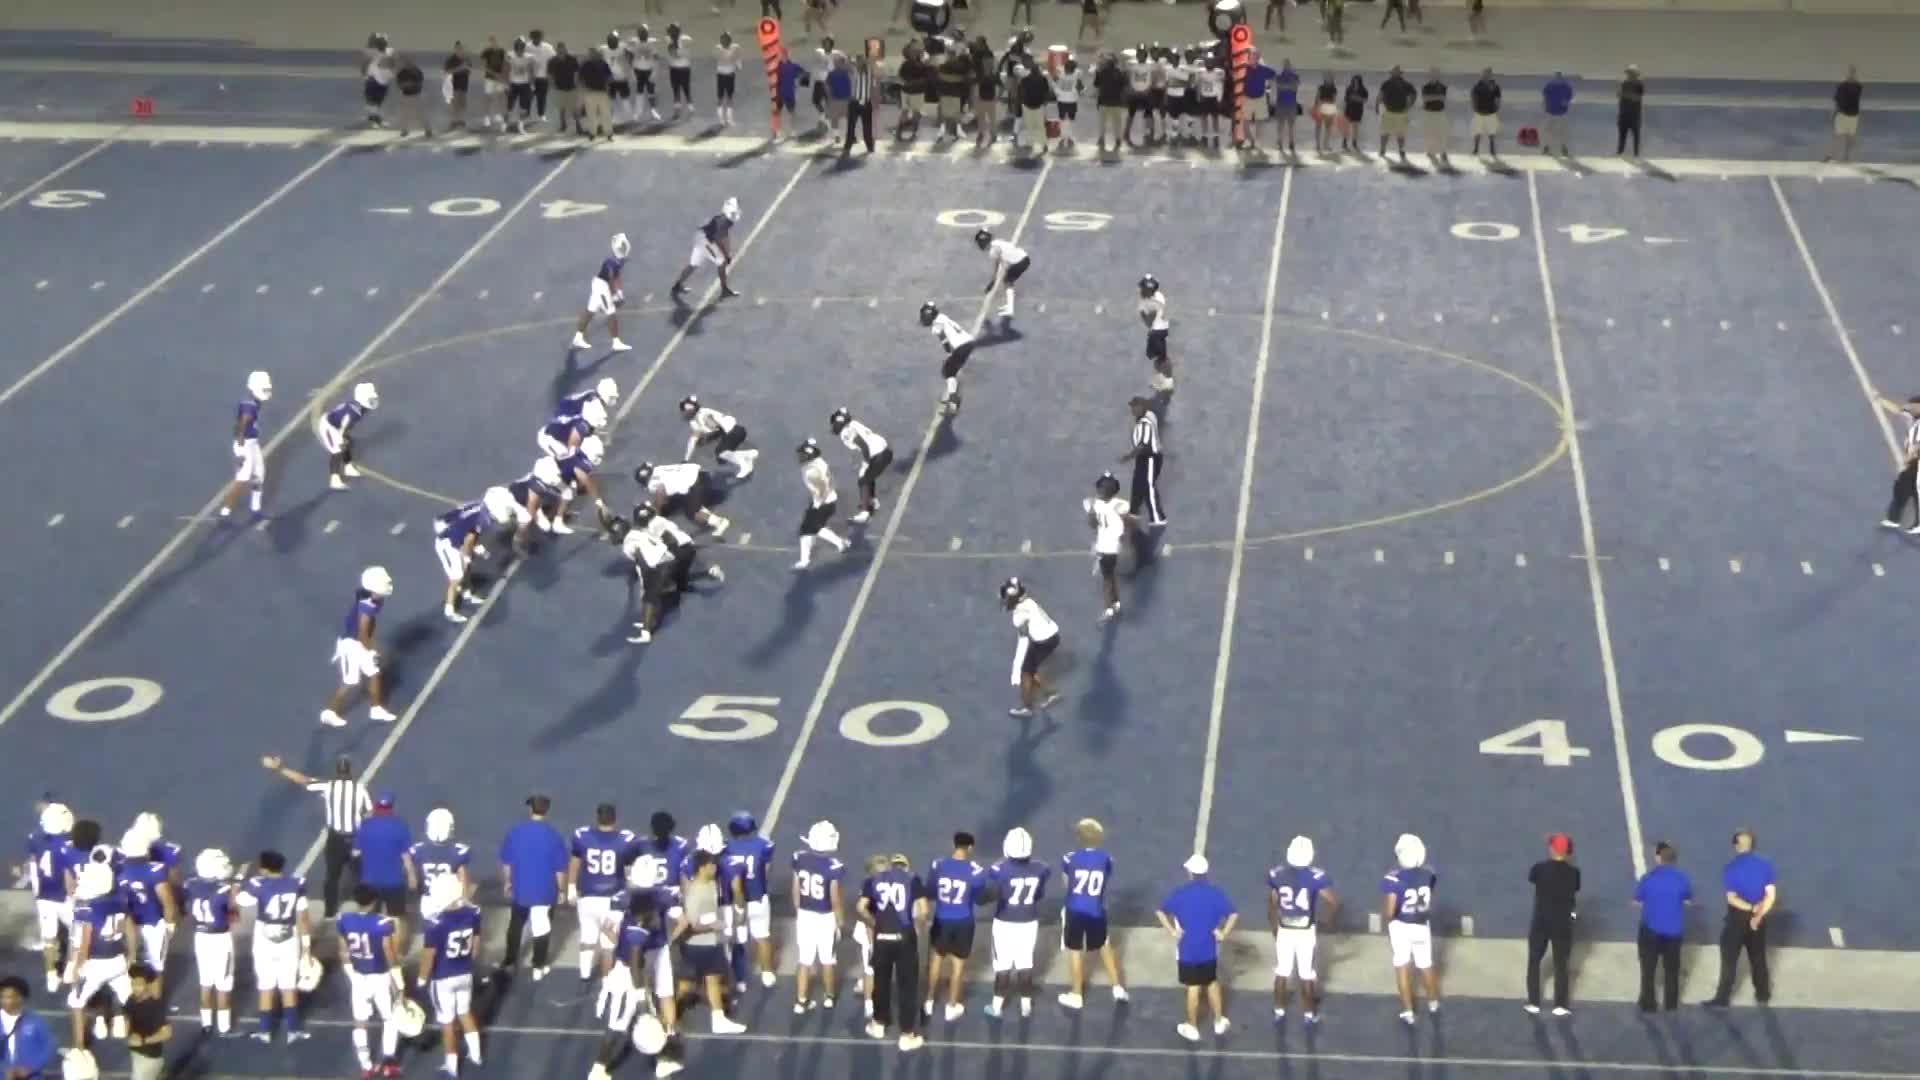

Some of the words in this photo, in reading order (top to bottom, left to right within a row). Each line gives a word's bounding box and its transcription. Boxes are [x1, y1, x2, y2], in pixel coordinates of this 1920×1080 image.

[29, 189, 106, 208] 3
[540, 200, 609, 219] 4
[1043, 210, 1114, 231] 5
[1557, 223, 1629, 244] 4
[45, 677, 164, 722] 0
[668, 695, 781, 741] 5
[839, 700, 950, 746] 0
[1479, 719, 1591, 766] 4
[1651, 723, 1765, 770] 0
[586, 849, 617, 876] 58
[798, 869, 825, 900] 36
[876, 881, 906, 912] 30
[938, 877, 967, 904] 27
[1008, 877, 1040, 905] 77
[1074, 870, 1105, 896] 70
[265, 892, 297, 920] 47
[1279, 886, 1310, 911] 24
[1401, 886, 1431, 912] 23
[347, 932, 374, 959] 21
